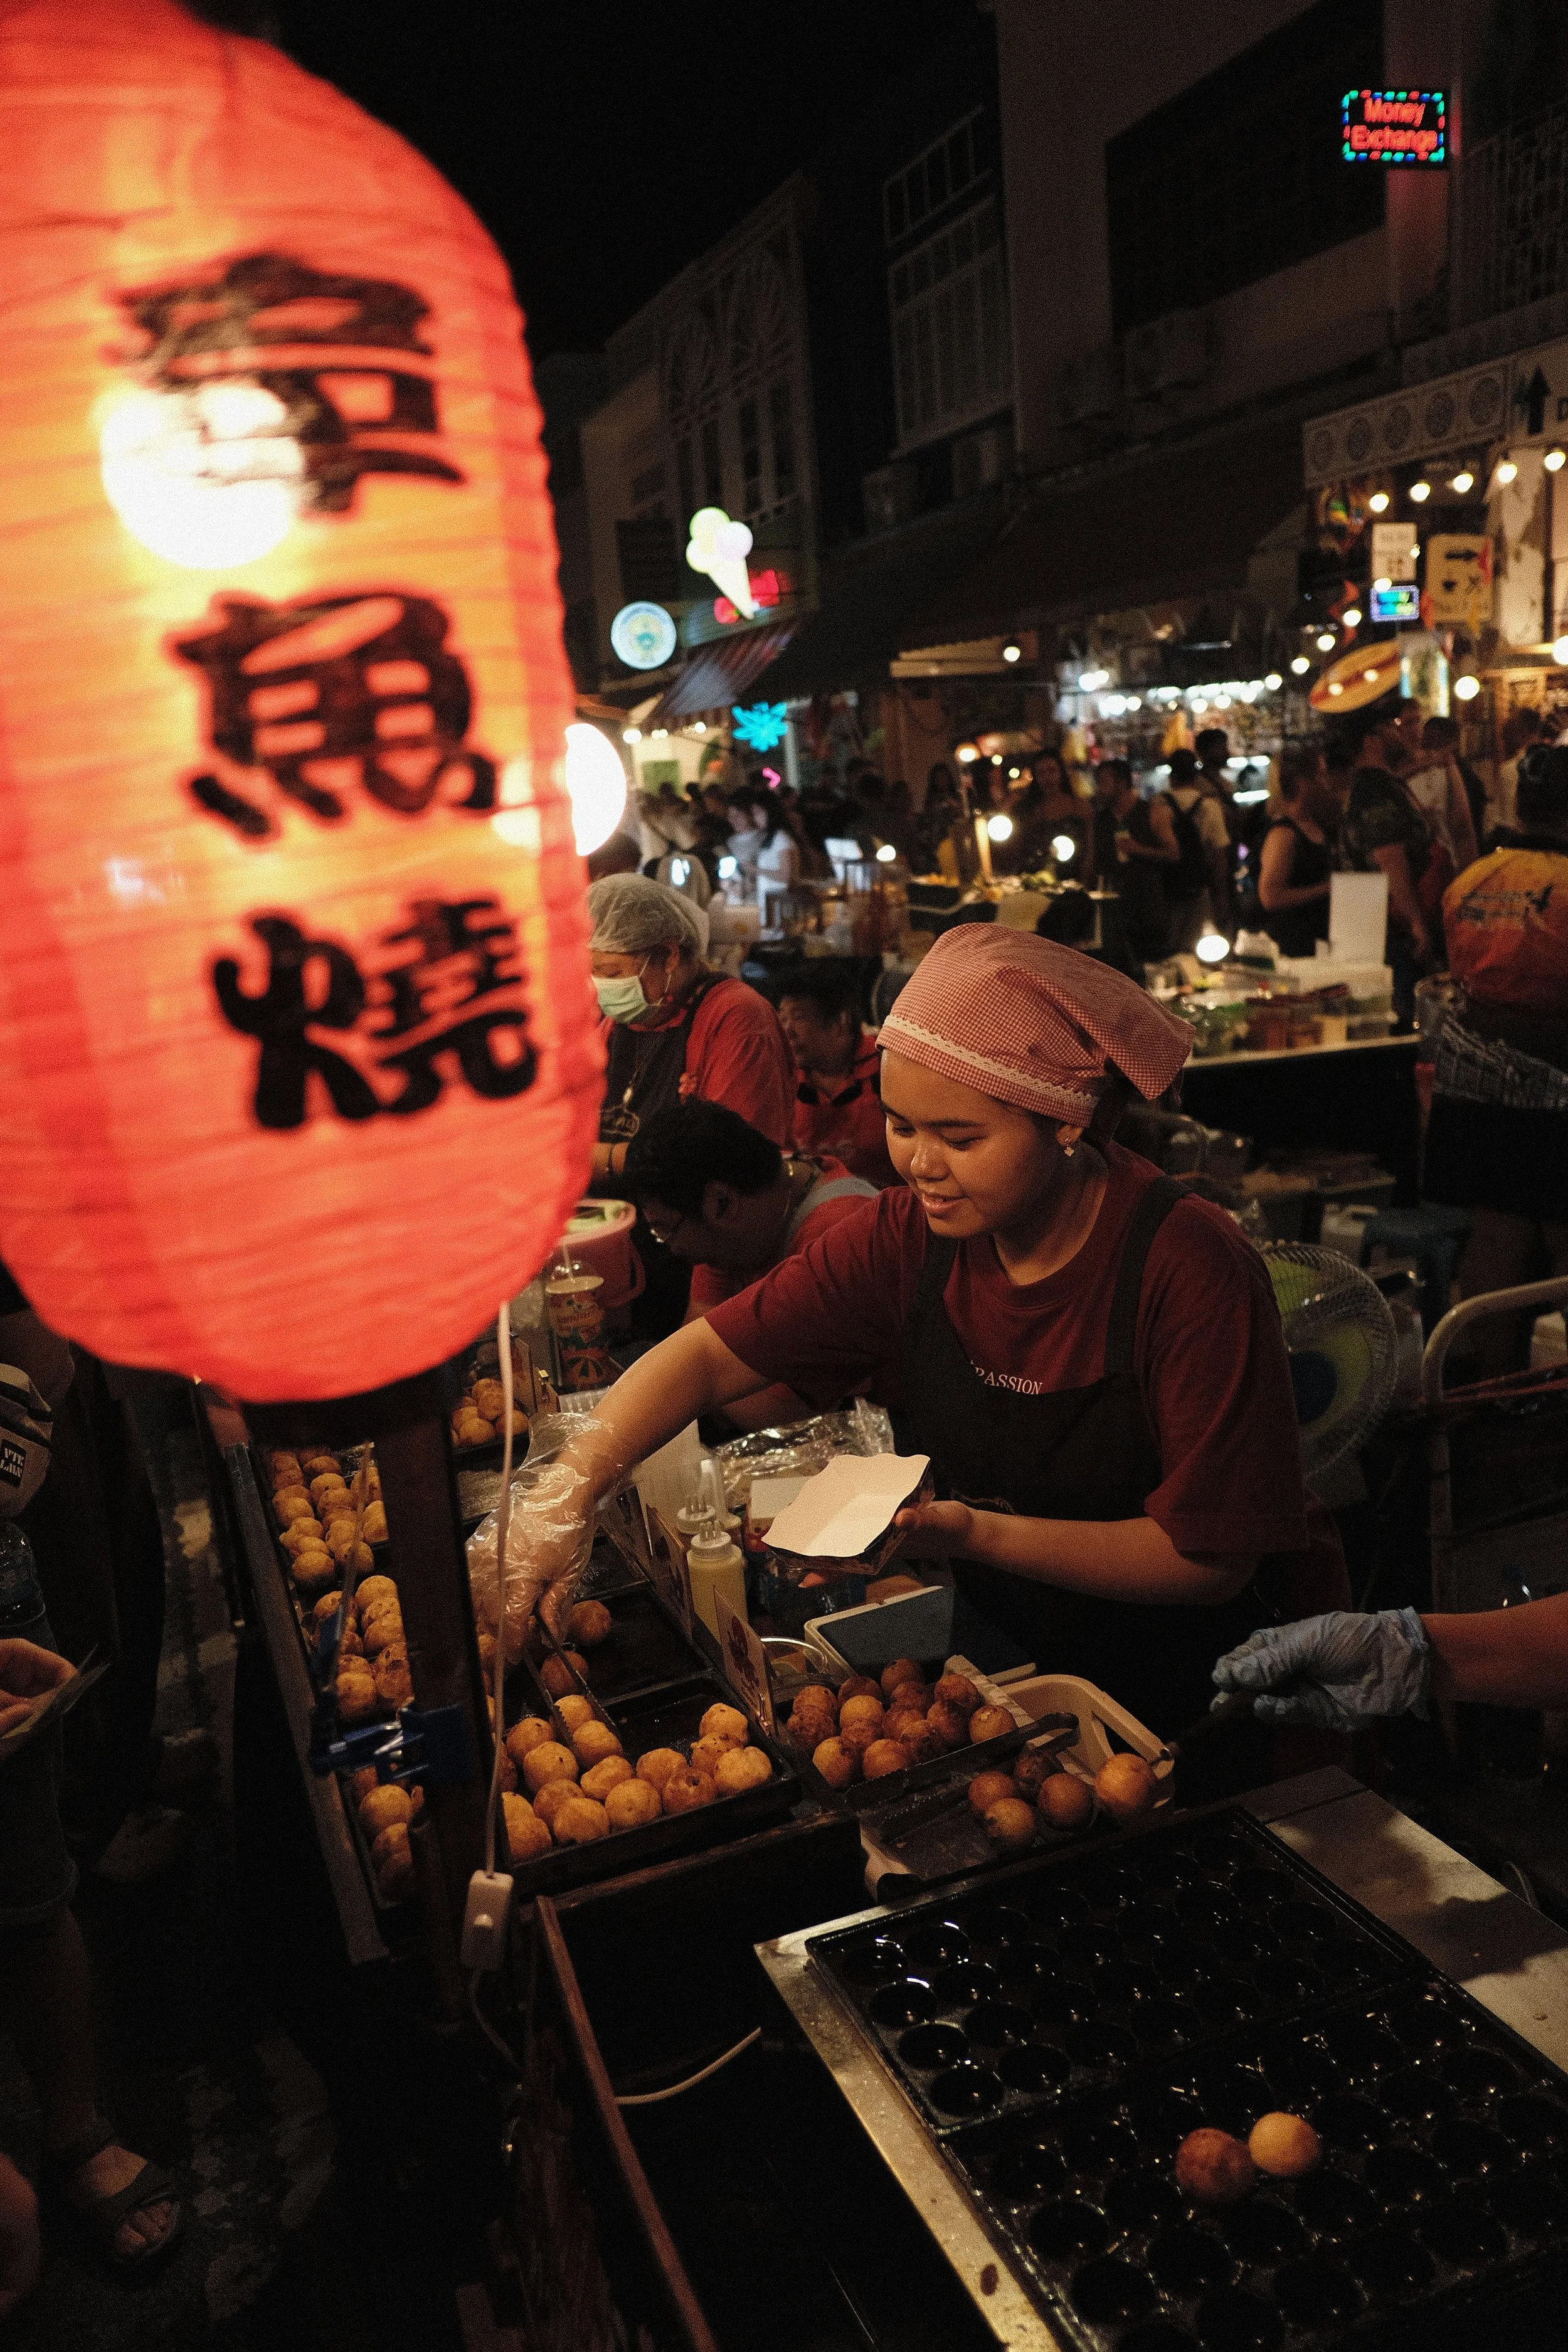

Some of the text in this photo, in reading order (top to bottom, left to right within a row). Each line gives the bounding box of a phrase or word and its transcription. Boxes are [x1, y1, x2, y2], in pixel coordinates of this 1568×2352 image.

[1365, 98, 1426, 127] Money
[1351, 125, 1438, 154] Exchange
[970, 1360, 1044, 1396] PASSION
